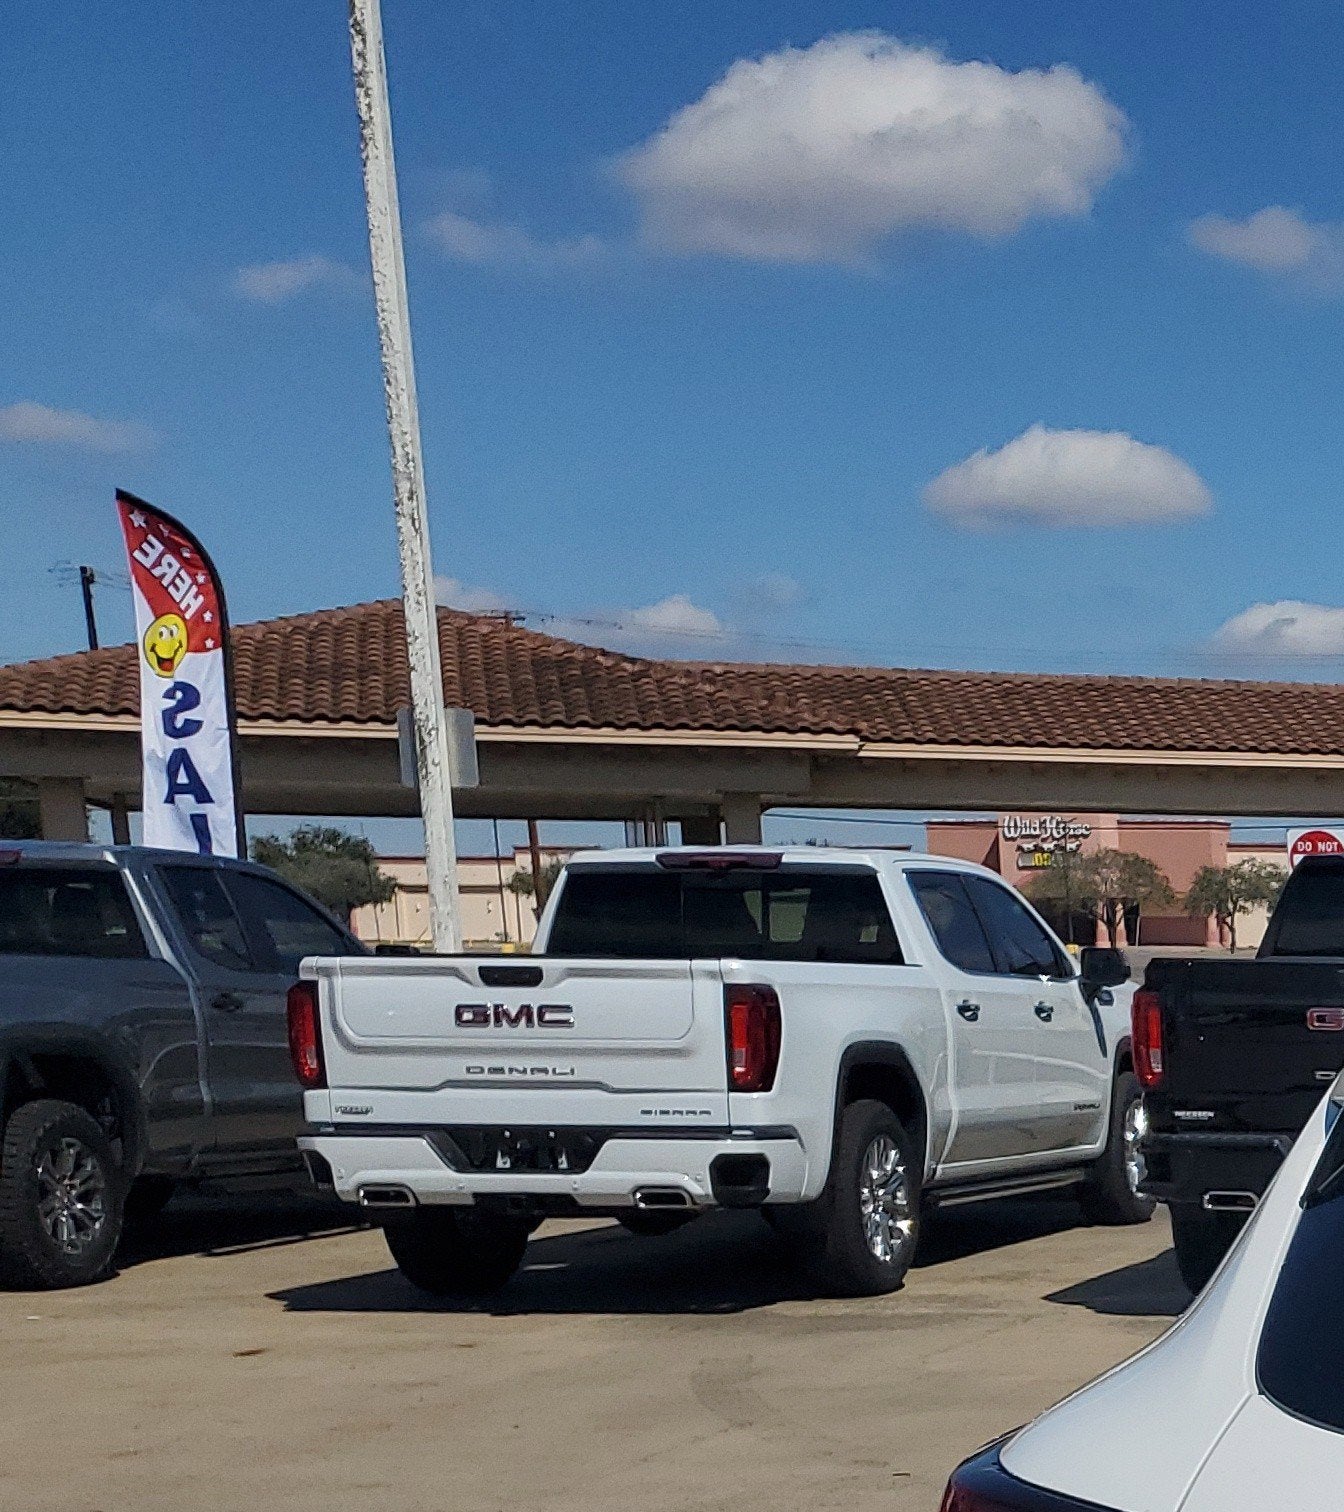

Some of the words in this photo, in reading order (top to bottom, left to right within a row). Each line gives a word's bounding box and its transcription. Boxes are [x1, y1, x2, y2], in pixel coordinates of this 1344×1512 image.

[1297, 841, 1313, 852] DO
[1317, 841, 1339, 852] NOT
[454, 1003, 575, 1028] GMC
[465, 1065, 576, 1077] DENALI
